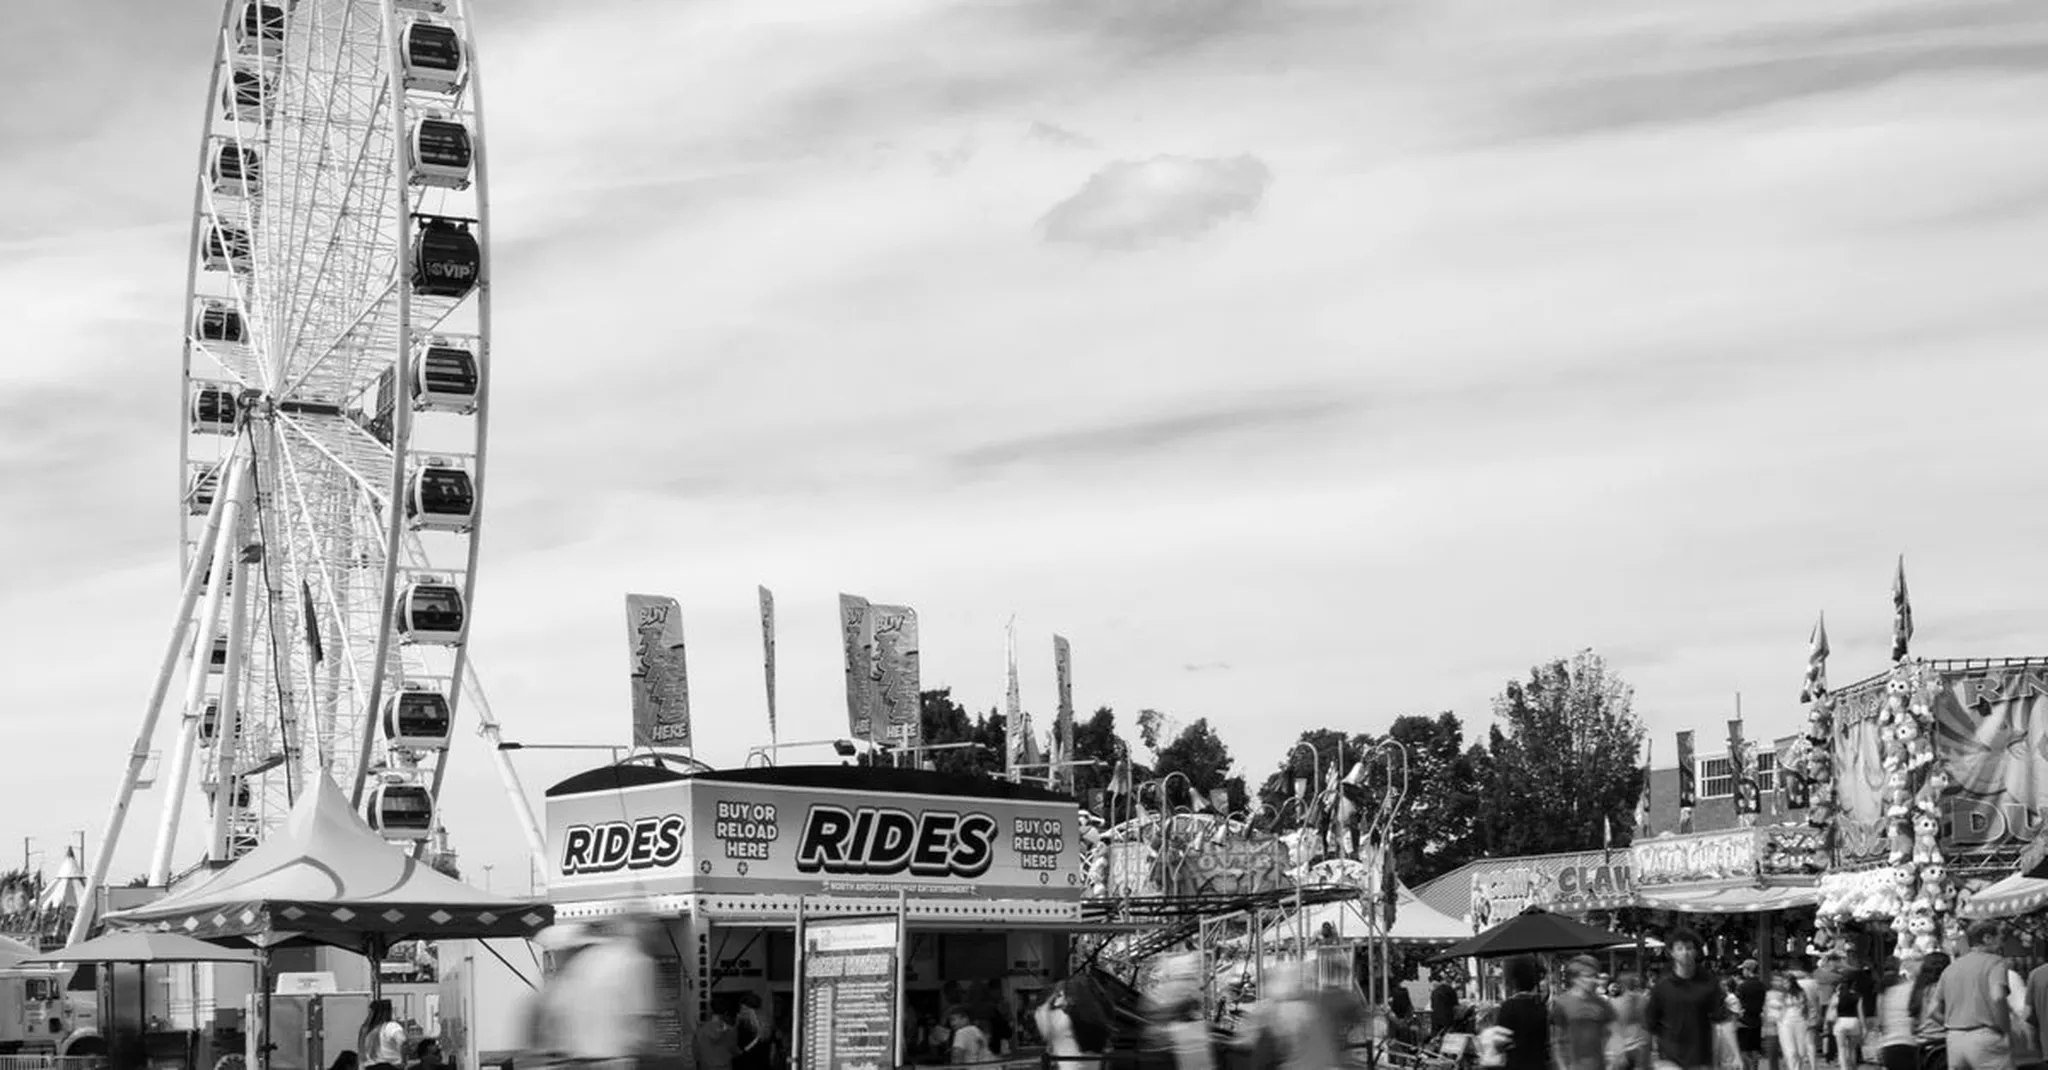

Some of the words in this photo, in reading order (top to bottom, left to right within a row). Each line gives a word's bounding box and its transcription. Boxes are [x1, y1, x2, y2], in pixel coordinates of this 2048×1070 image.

[443, 263, 470, 279] VIP
[640, 606, 668, 626] BUY
[876, 615, 905, 634] BUY
[652, 723, 688, 742] HERE
[718, 802, 749, 819] BUY
[753, 804, 776, 821] OR
[716, 821, 778, 840] RELOAD
[1014, 818, 1040, 835] BUY
[1042, 820, 1062, 836] OR
[562, 814, 685, 874] RIDES
[725, 840, 769, 859] HERE
[797, 805, 997, 876] RIDES
[1012, 835, 1064, 852] RELOAD
[1021, 853, 1057, 869] HERE
[1687, 841, 1720, 869] GUN
